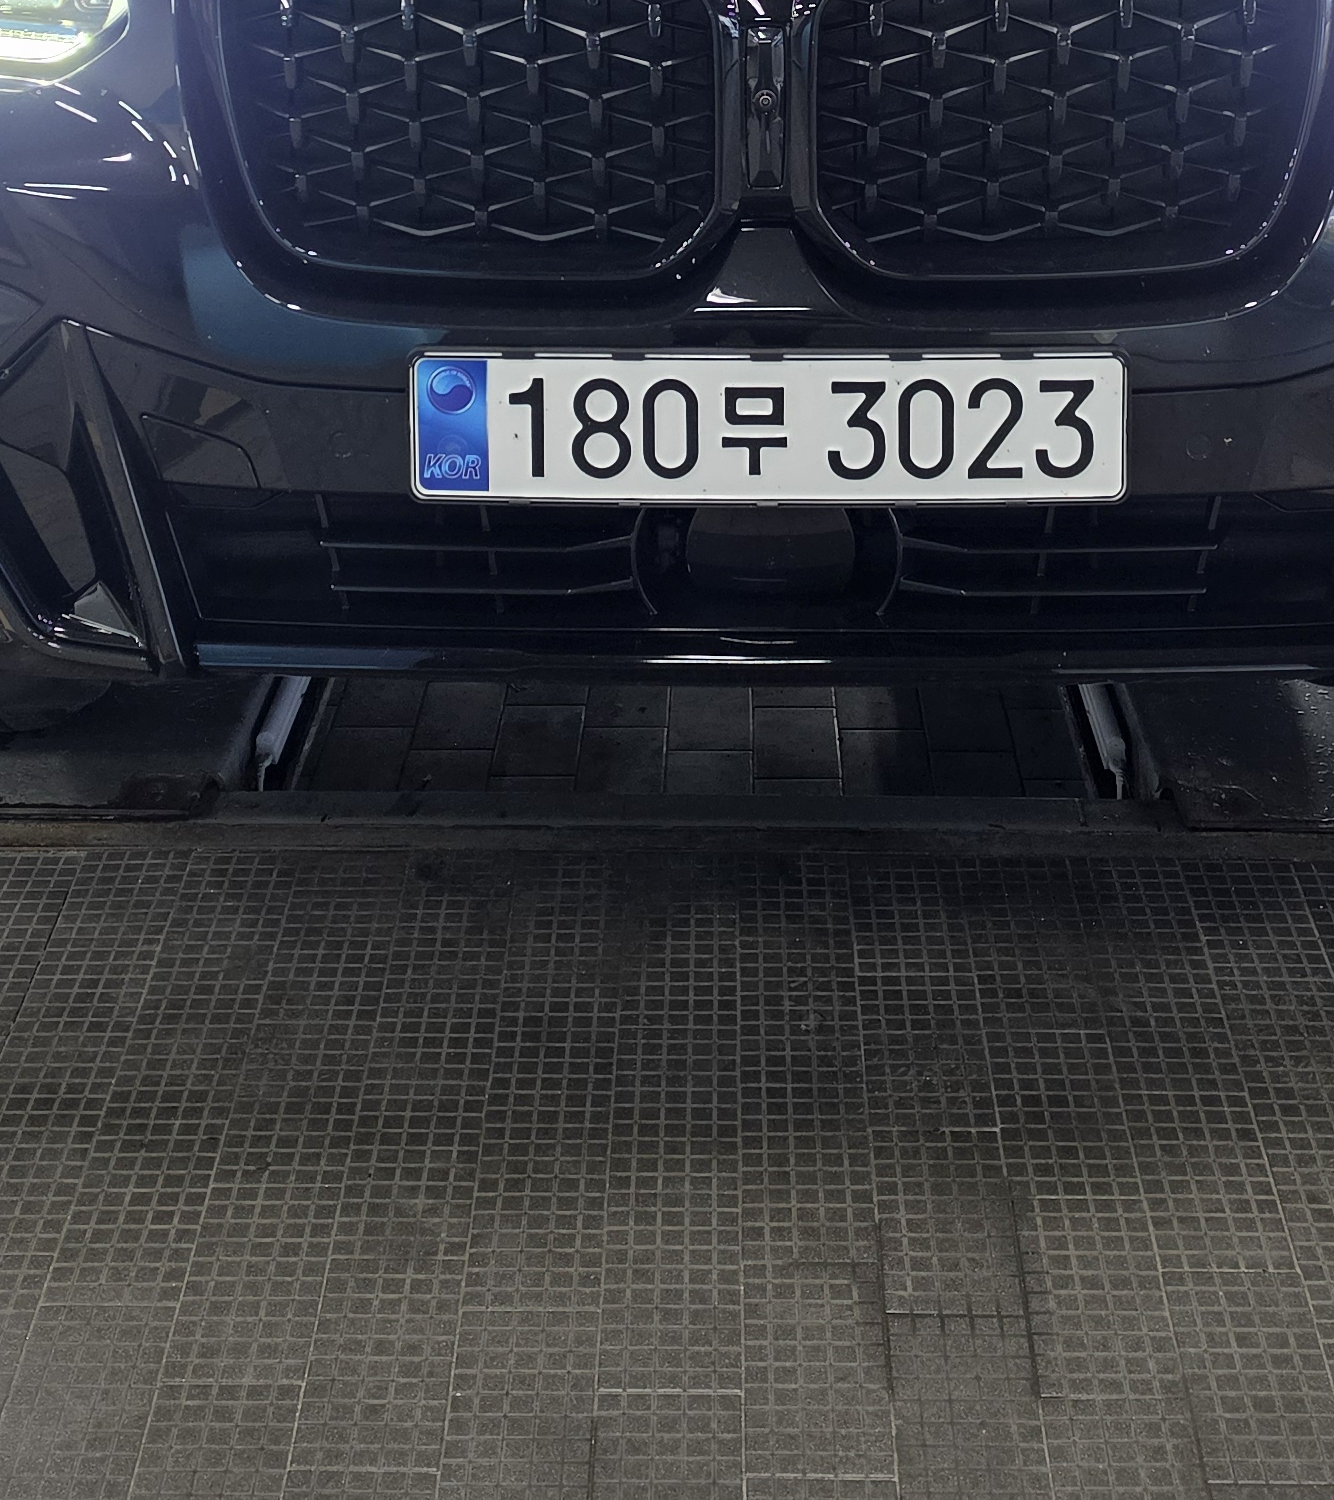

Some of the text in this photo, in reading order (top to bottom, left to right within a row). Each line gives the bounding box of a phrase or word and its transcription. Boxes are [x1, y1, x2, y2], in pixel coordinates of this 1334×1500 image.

[508, 376, 1096, 480] 180무 3023
[423, 453, 482, 479] KOR
